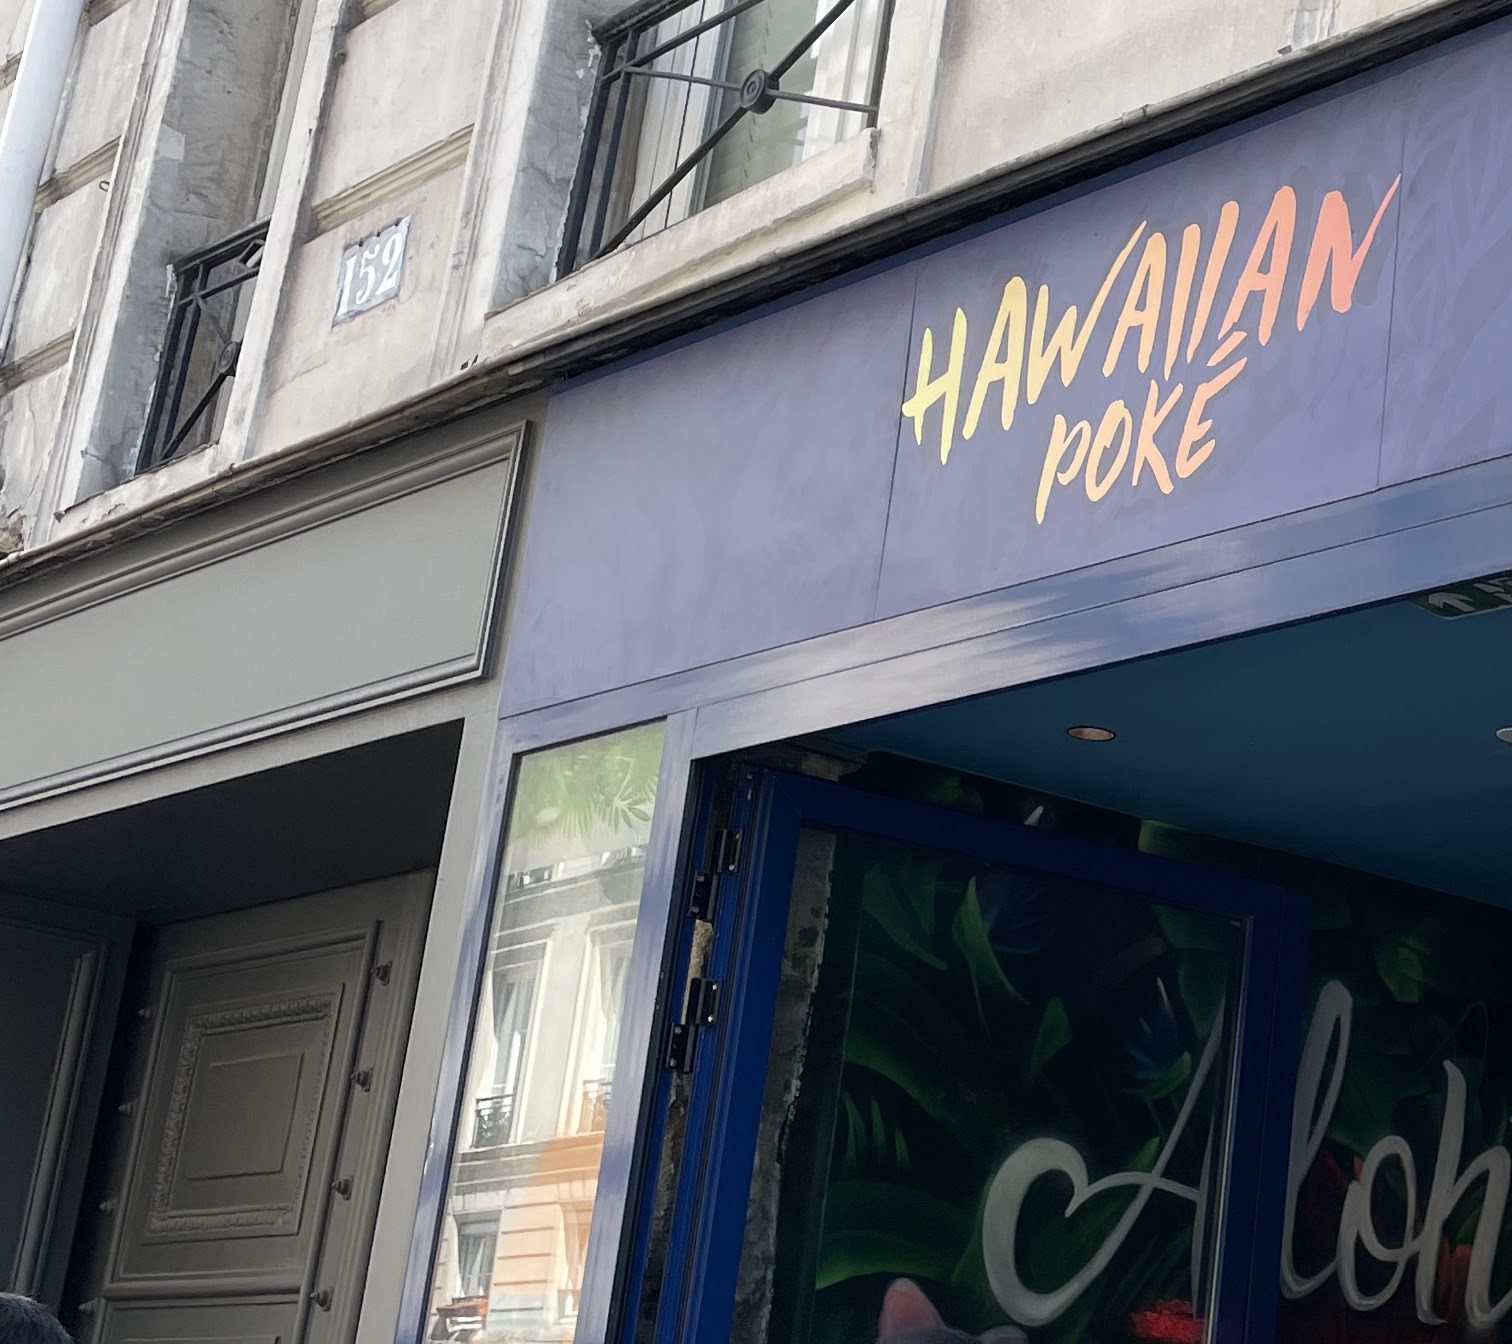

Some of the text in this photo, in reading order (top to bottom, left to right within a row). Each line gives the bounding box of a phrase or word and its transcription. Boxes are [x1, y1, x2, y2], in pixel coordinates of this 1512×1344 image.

[336, 232, 403, 317] 152
[901, 173, 1402, 466] HAWAIIAN
[1036, 331, 1248, 525] POKÉ
